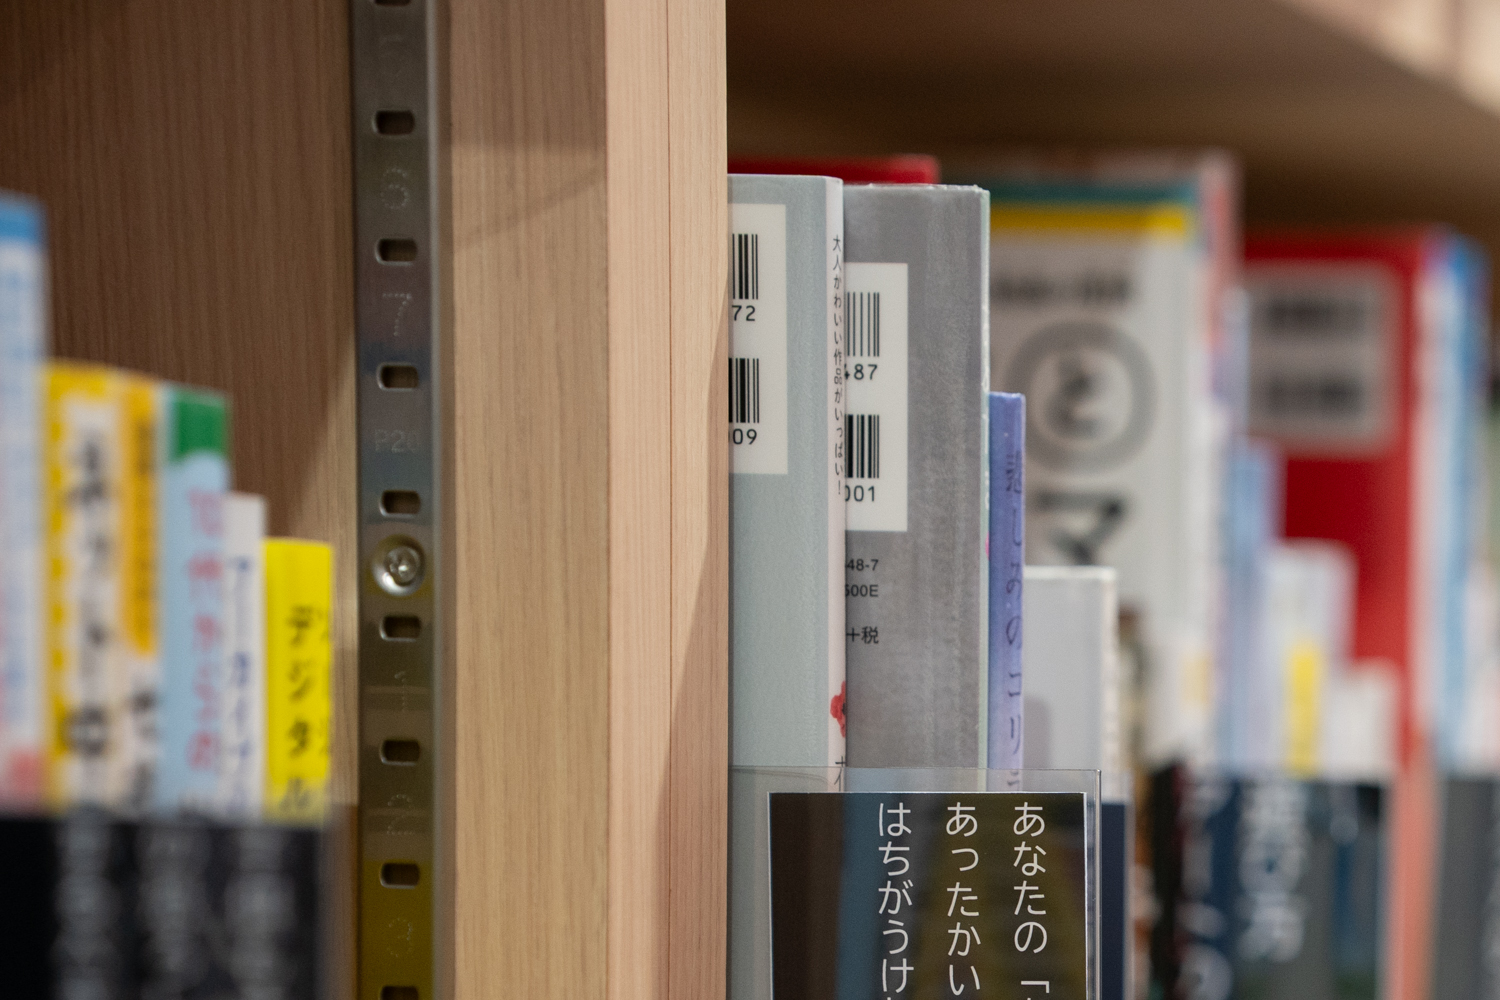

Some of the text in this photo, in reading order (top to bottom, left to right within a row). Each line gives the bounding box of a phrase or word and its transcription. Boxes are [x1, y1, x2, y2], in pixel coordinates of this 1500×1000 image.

[381, 167, 410, 210] 6
[382, 292, 412, 337] 7
[728, 428, 758, 446] 09
[387, 793, 415, 836] 2
